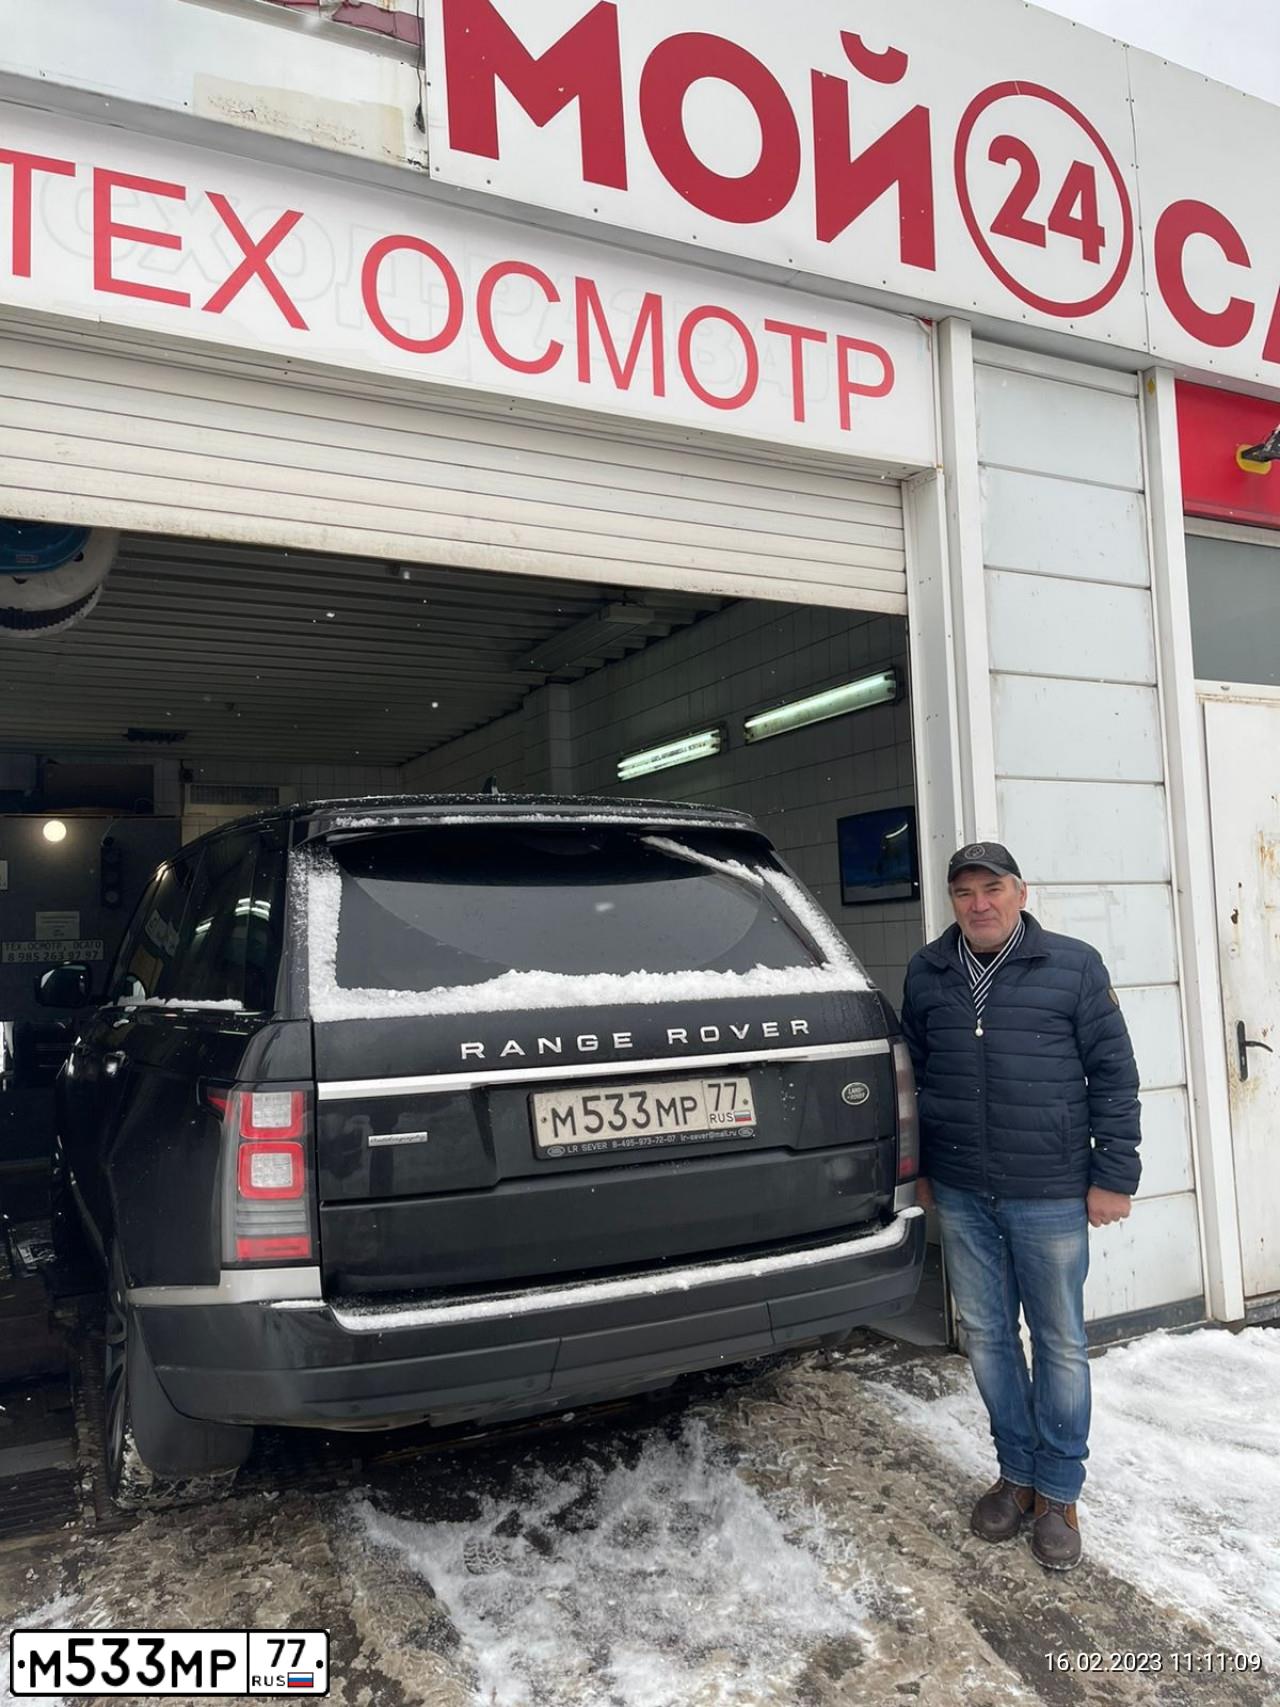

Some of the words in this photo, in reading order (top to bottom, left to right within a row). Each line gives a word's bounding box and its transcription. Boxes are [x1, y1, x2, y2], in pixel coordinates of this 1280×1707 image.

[442, 0, 937, 272] МОЙ
[987, 135, 1106, 264] 24
[0, 148, 309, 332] ТЕХ
[360, 235, 896, 431] ОСМОТР
[43, 951, 65, 960] 263
[461, 1031, 633, 1060] RANGE
[667, 1019, 810, 1045] ROVER
[551, 1090, 698, 1138] М533МР
[707, 1082, 738, 1112] 77
[709, 1113, 734, 1124] RUS
[567, 1146, 579, 1154] LR
[582, 1142, 608, 1152] SEVER
